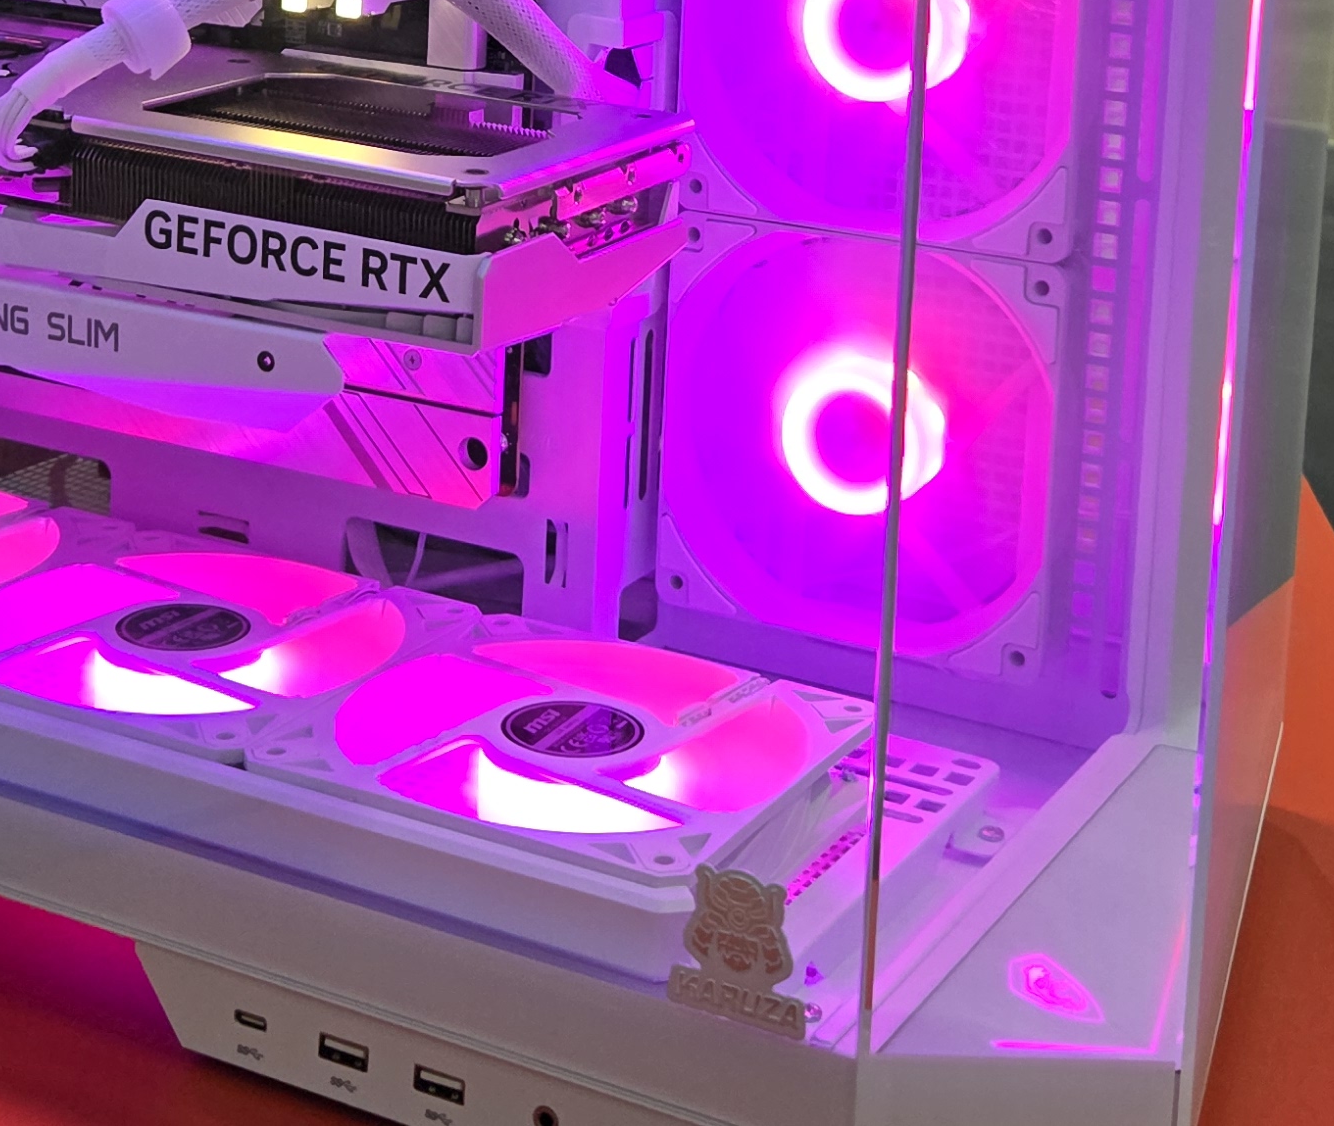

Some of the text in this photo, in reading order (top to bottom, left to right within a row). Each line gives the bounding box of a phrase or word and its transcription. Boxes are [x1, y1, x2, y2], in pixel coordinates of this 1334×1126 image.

[144, 210, 451, 303] GEFORCE RTX
[47, 311, 120, 353] SLIM
[522, 708, 561, 734] msi
[676, 969, 799, 1029] KARUZA
